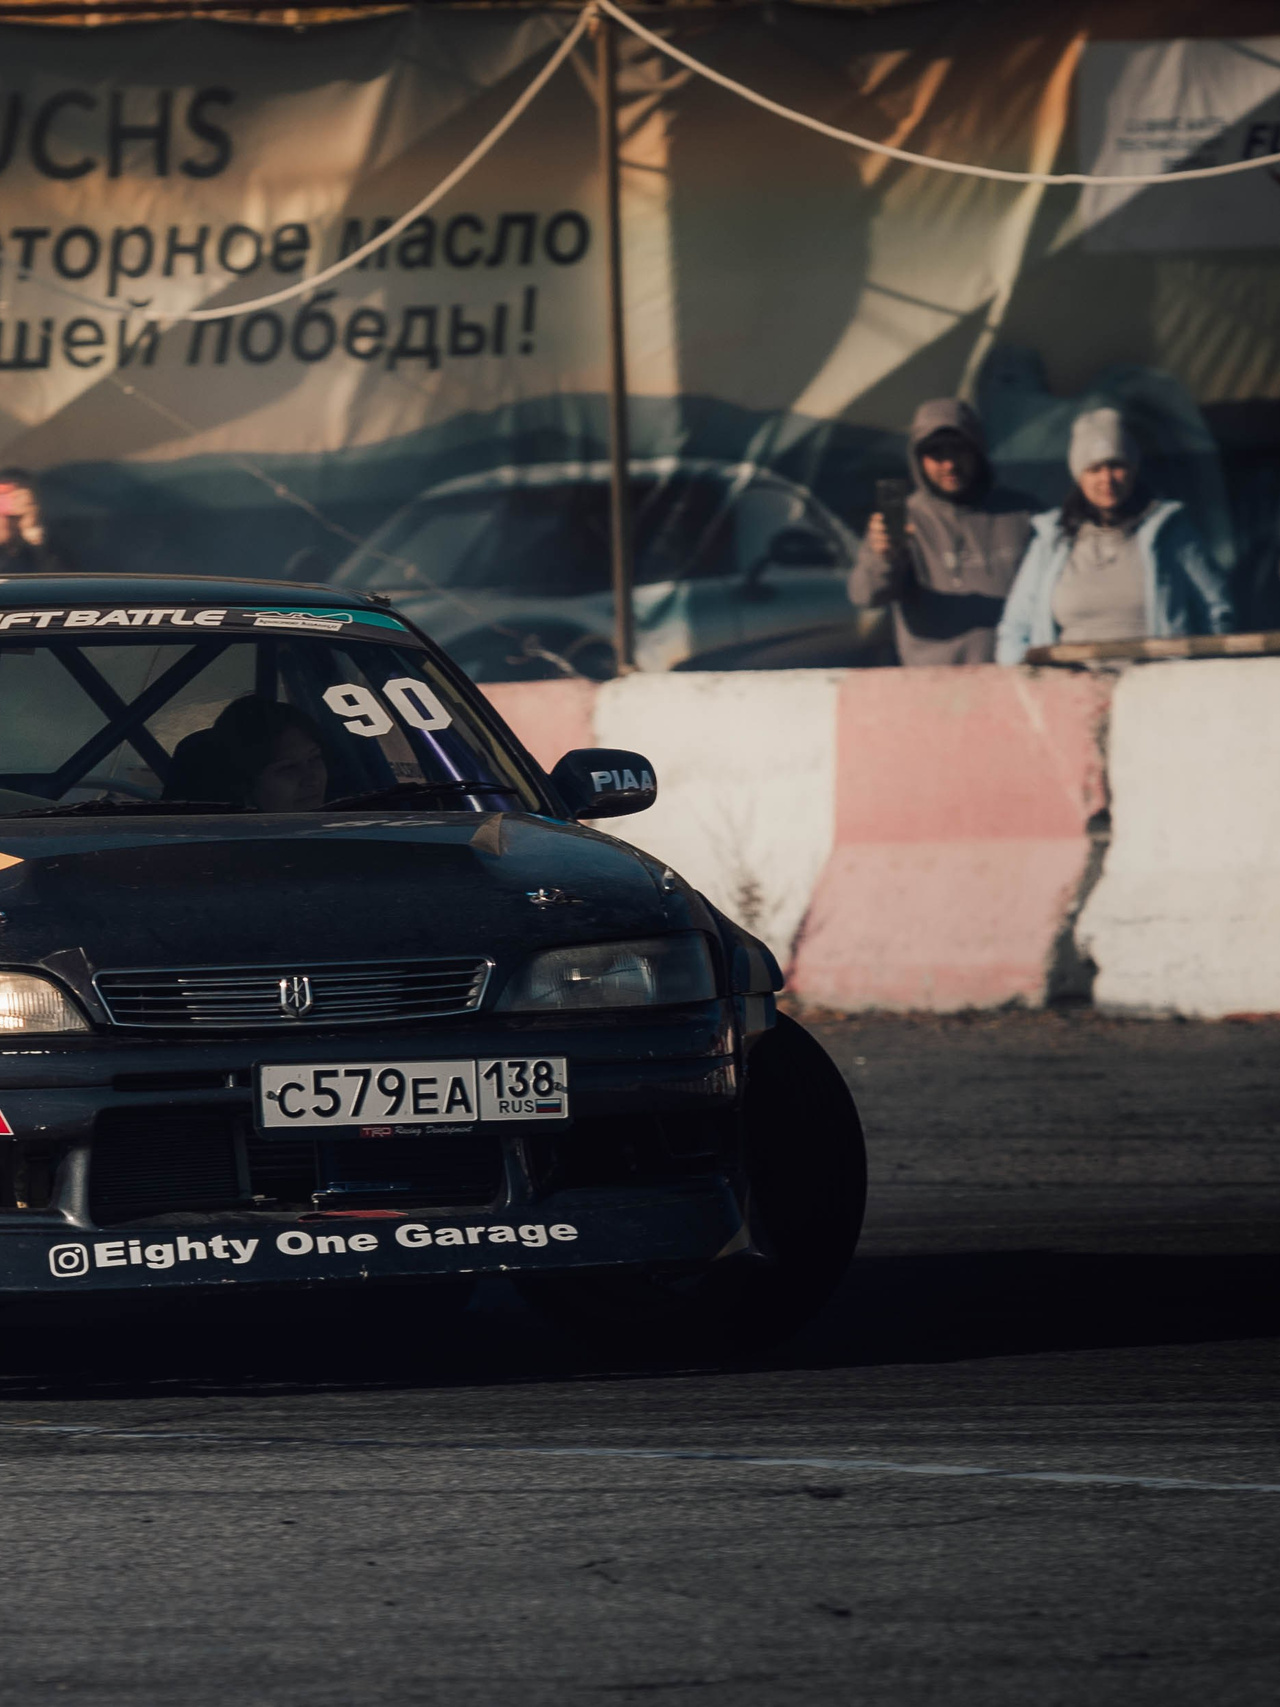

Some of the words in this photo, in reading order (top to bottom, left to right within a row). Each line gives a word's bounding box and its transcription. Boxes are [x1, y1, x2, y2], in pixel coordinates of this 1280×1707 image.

[338, 209, 591, 271] масло
[186, 285, 538, 371] победы!
[62, 609, 228, 628] BATTLE
[321, 677, 453, 737] 90
[590, 769, 654, 793] PIAA
[482, 1060, 555, 1099] 138
[498, 1100, 535, 1114] RUS
[93, 1234, 260, 1269] Eighty
[275, 1230, 379, 1255] One
[394, 1223, 579, 1248] Garage
